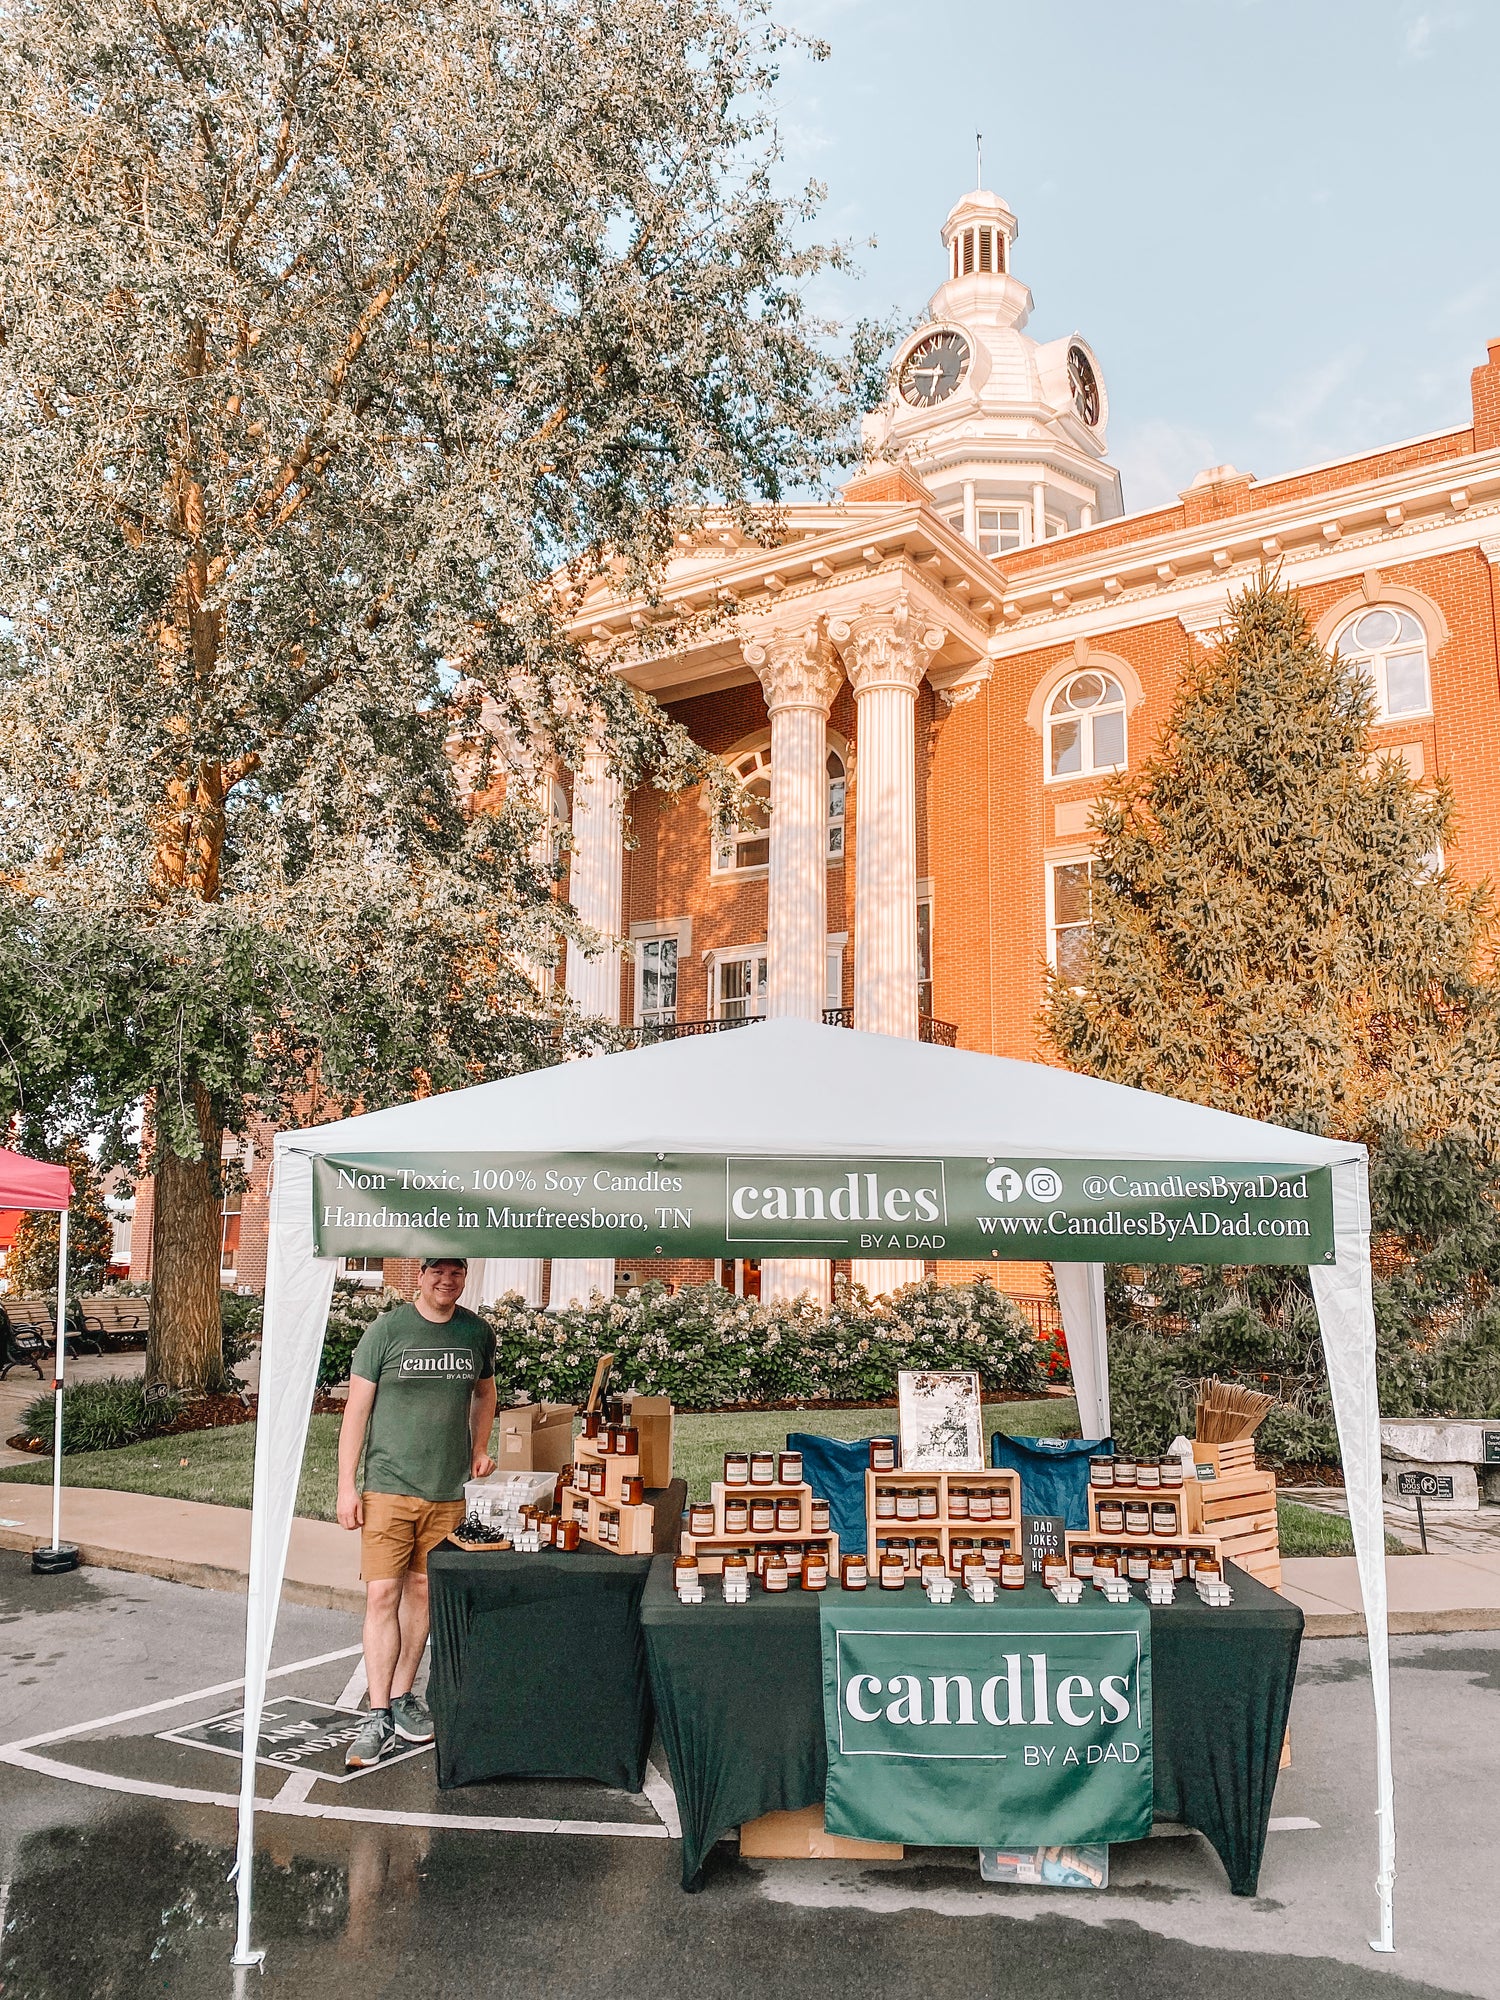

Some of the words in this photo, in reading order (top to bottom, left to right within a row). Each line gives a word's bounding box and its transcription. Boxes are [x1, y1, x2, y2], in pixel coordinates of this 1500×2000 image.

[336, 1168, 465, 1193] Non-Toxic,
[471, 1169, 537, 1191] 100%
[544, 1171, 587, 1196] Soy
[593, 1171, 683, 1192] Candles
[1082, 1175, 1309, 1204] @CandlesByaDad
[731, 1173, 940, 1222] candles
[322, 1206, 451, 1228] Handmade
[457, 1206, 480, 1228] in
[486, 1207, 649, 1231] Murfreesboro,
[655, 1207, 693, 1229] TN
[976, 1210, 1311, 1242] www.CandlesByADad.com
[860, 1234, 884, 1248] BY
[887, 1235, 901, 1248] A
[905, 1235, 946, 1249] DAD
[402, 1353, 473, 1371] candles
[1033, 1521, 1053, 1533] DAD
[1028, 1534, 1058, 1546] JOKES
[1032, 1560, 1043, 1572] HE
[845, 1653, 1132, 1727] candles
[258, 1720, 319, 1744] ANY
[1024, 1745, 1056, 1766] BY
[1062, 1746, 1080, 1766] A
[1087, 1743, 1140, 1765] DAD
